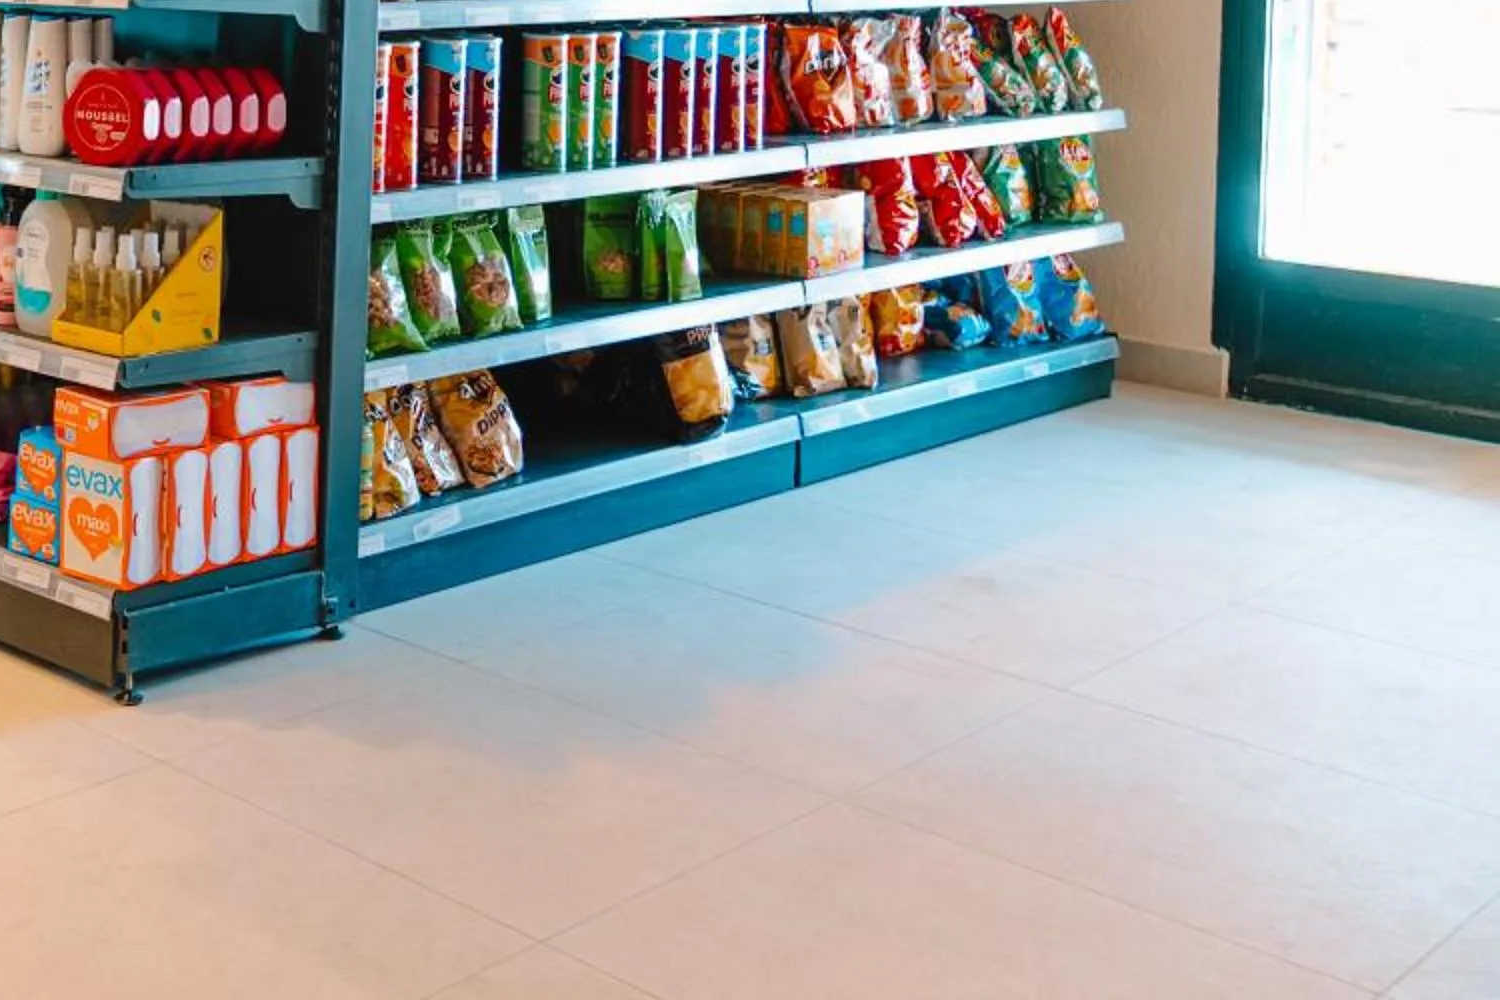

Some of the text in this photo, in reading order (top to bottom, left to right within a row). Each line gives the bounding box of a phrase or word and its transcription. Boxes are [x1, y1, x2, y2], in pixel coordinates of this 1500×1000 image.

[76, 109, 129, 123] MOUSSEL
[20, 442, 56, 470] evax
[65, 463, 124, 498] evax
[12, 502, 55, 528] evax
